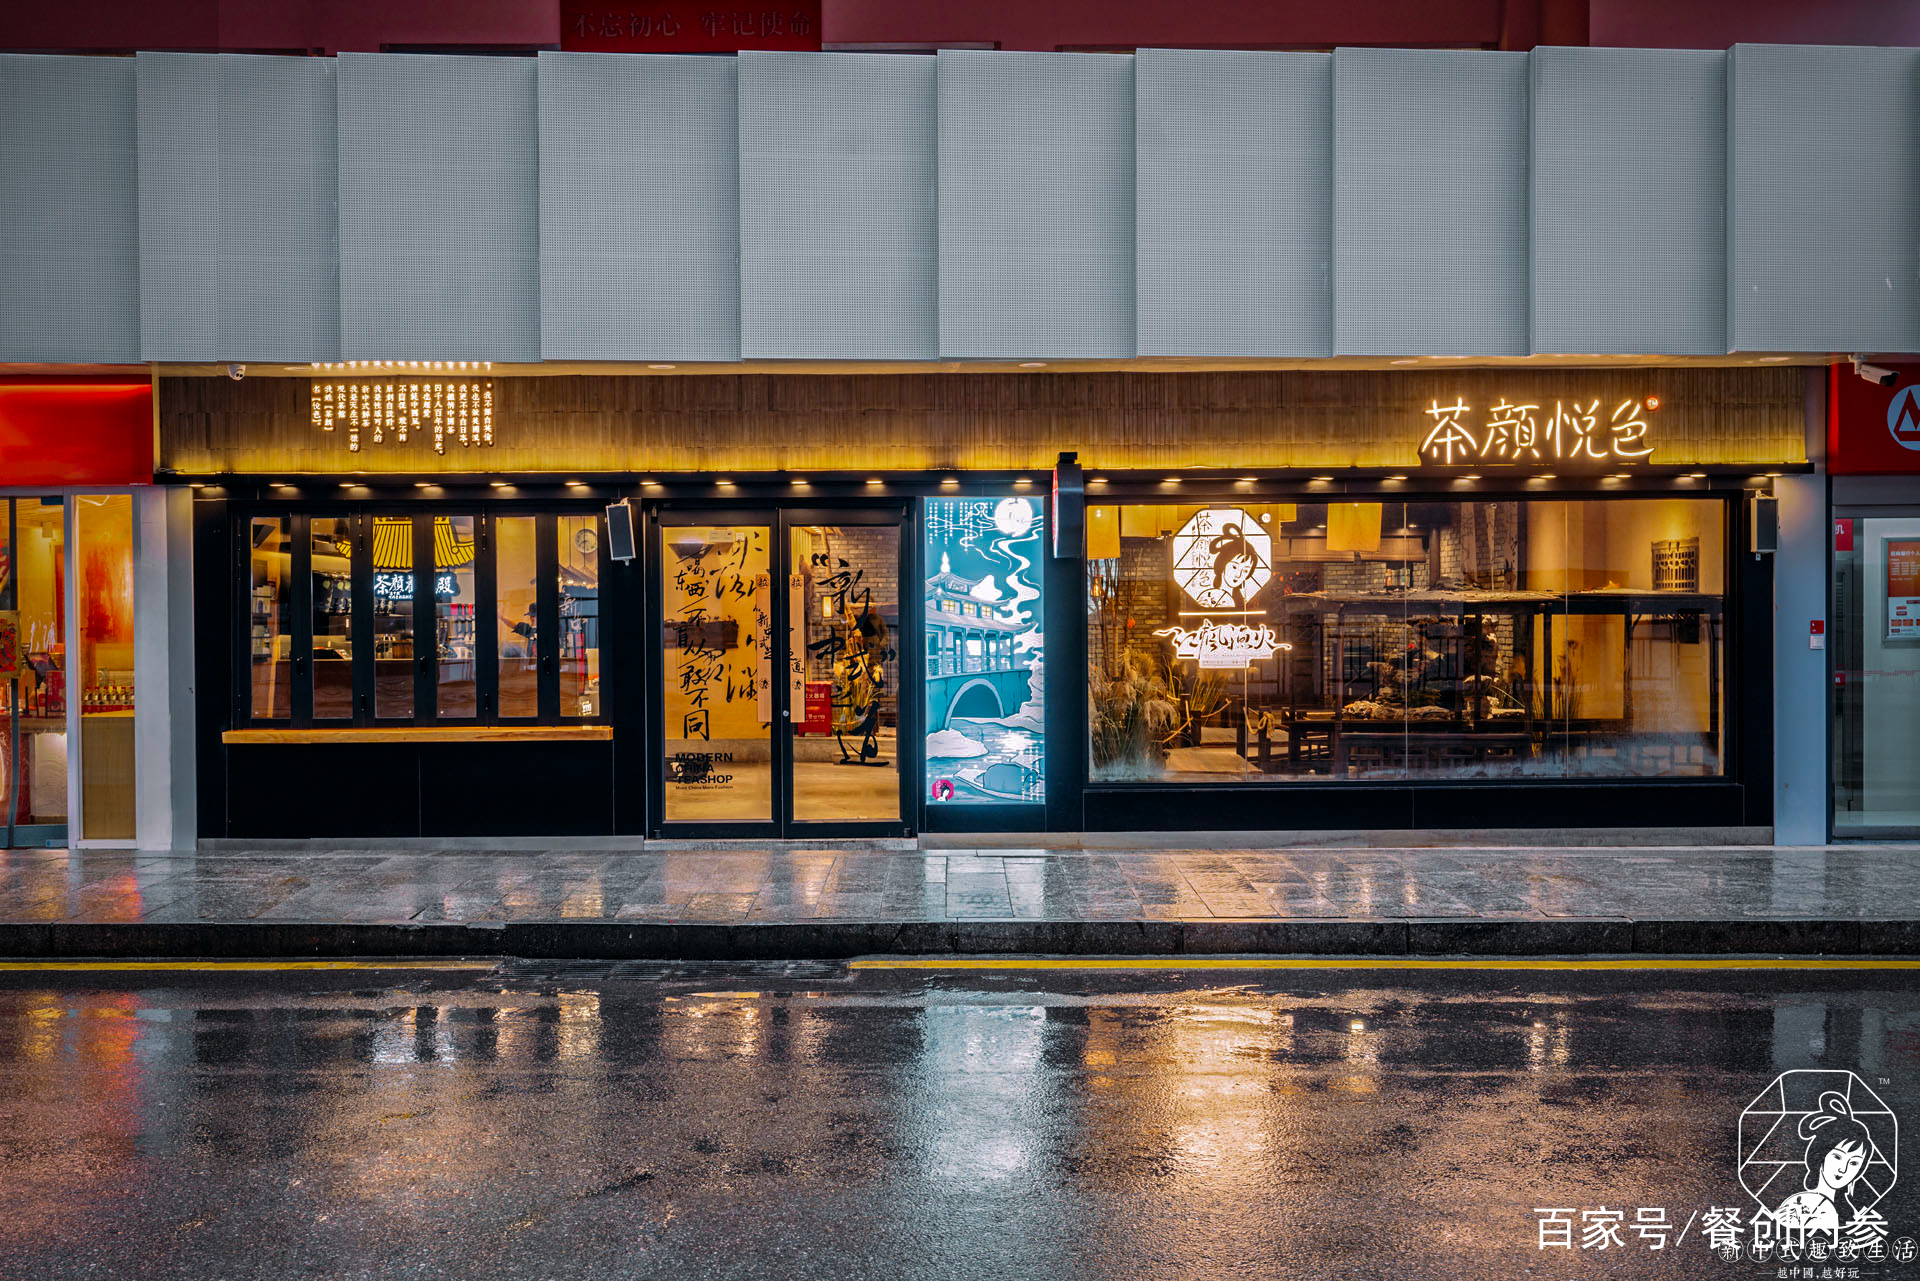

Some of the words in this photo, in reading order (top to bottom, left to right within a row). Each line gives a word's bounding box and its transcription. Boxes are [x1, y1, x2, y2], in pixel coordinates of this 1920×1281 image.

[575, 12, 681, 38] 不忘初心
[701, 12, 812, 37] 牢记使命
[675, 753, 733, 762] MODERN
[675, 764, 715, 773] CHINA
[676, 775, 733, 784] TEASHOP
